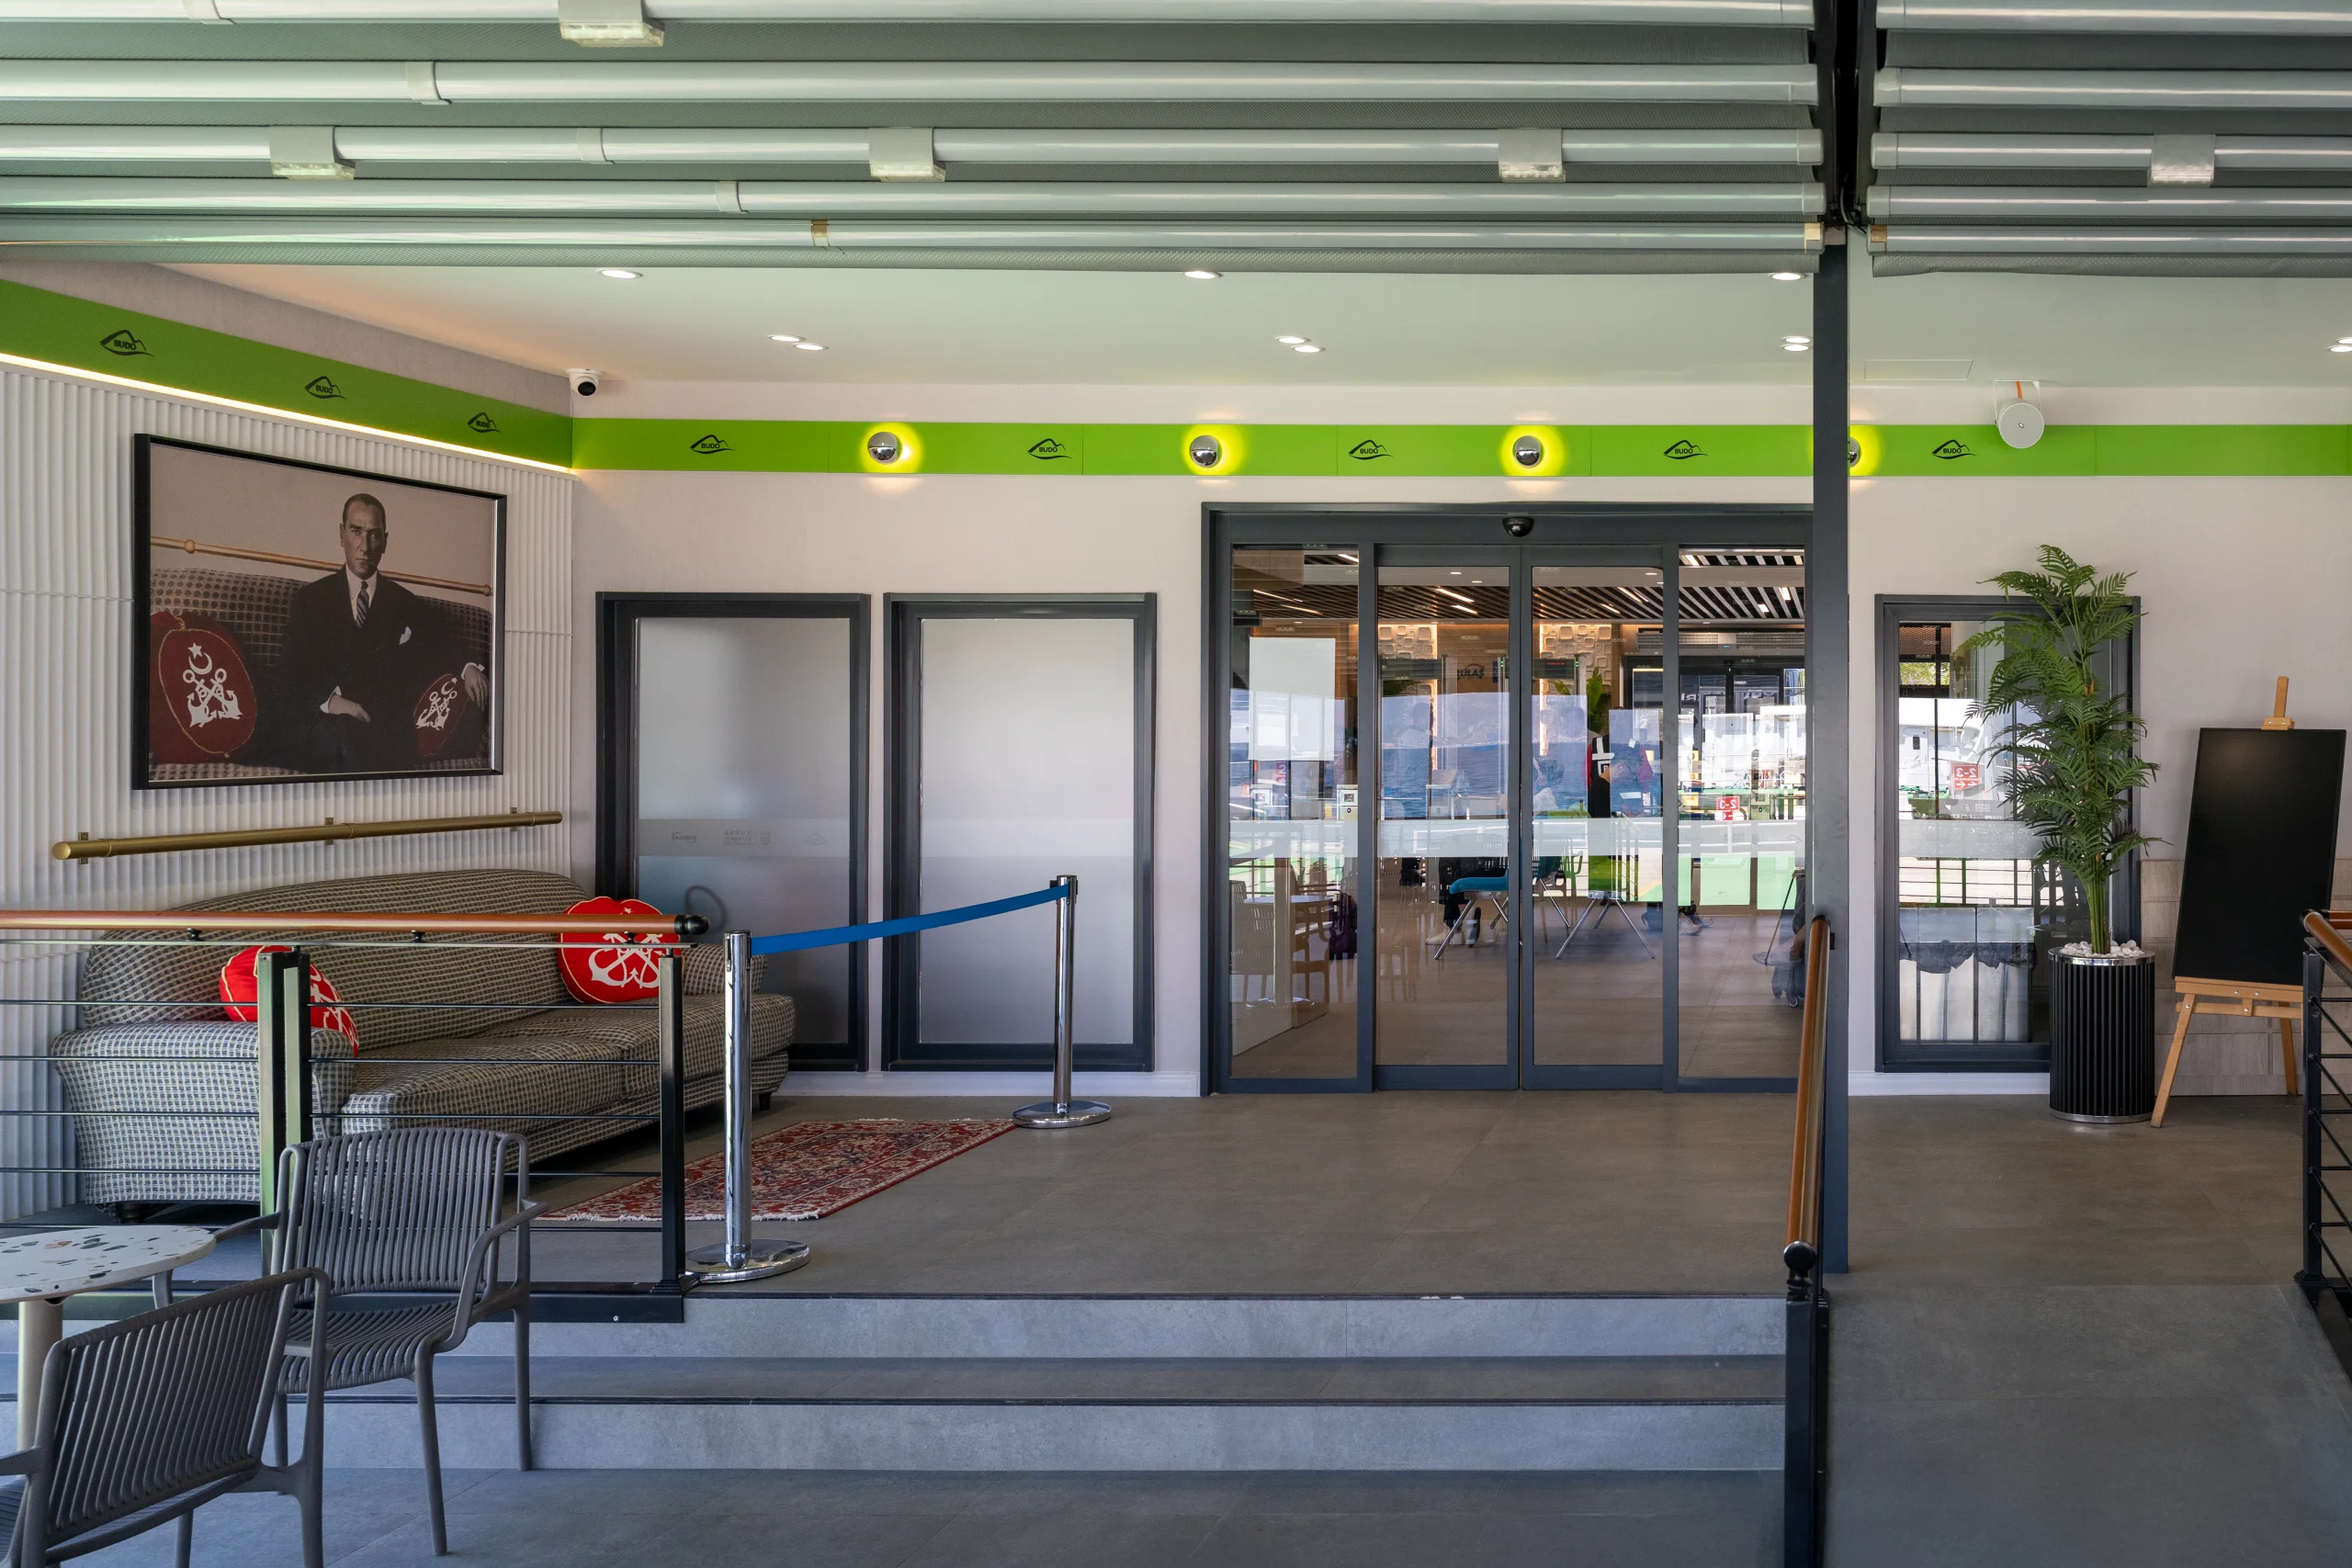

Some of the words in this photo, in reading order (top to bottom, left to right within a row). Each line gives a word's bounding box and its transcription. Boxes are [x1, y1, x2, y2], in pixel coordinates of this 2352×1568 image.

[114, 339, 137, 351] BUDO
[316, 384, 334, 395] BUDO
[476, 420, 491, 429] BUDO
